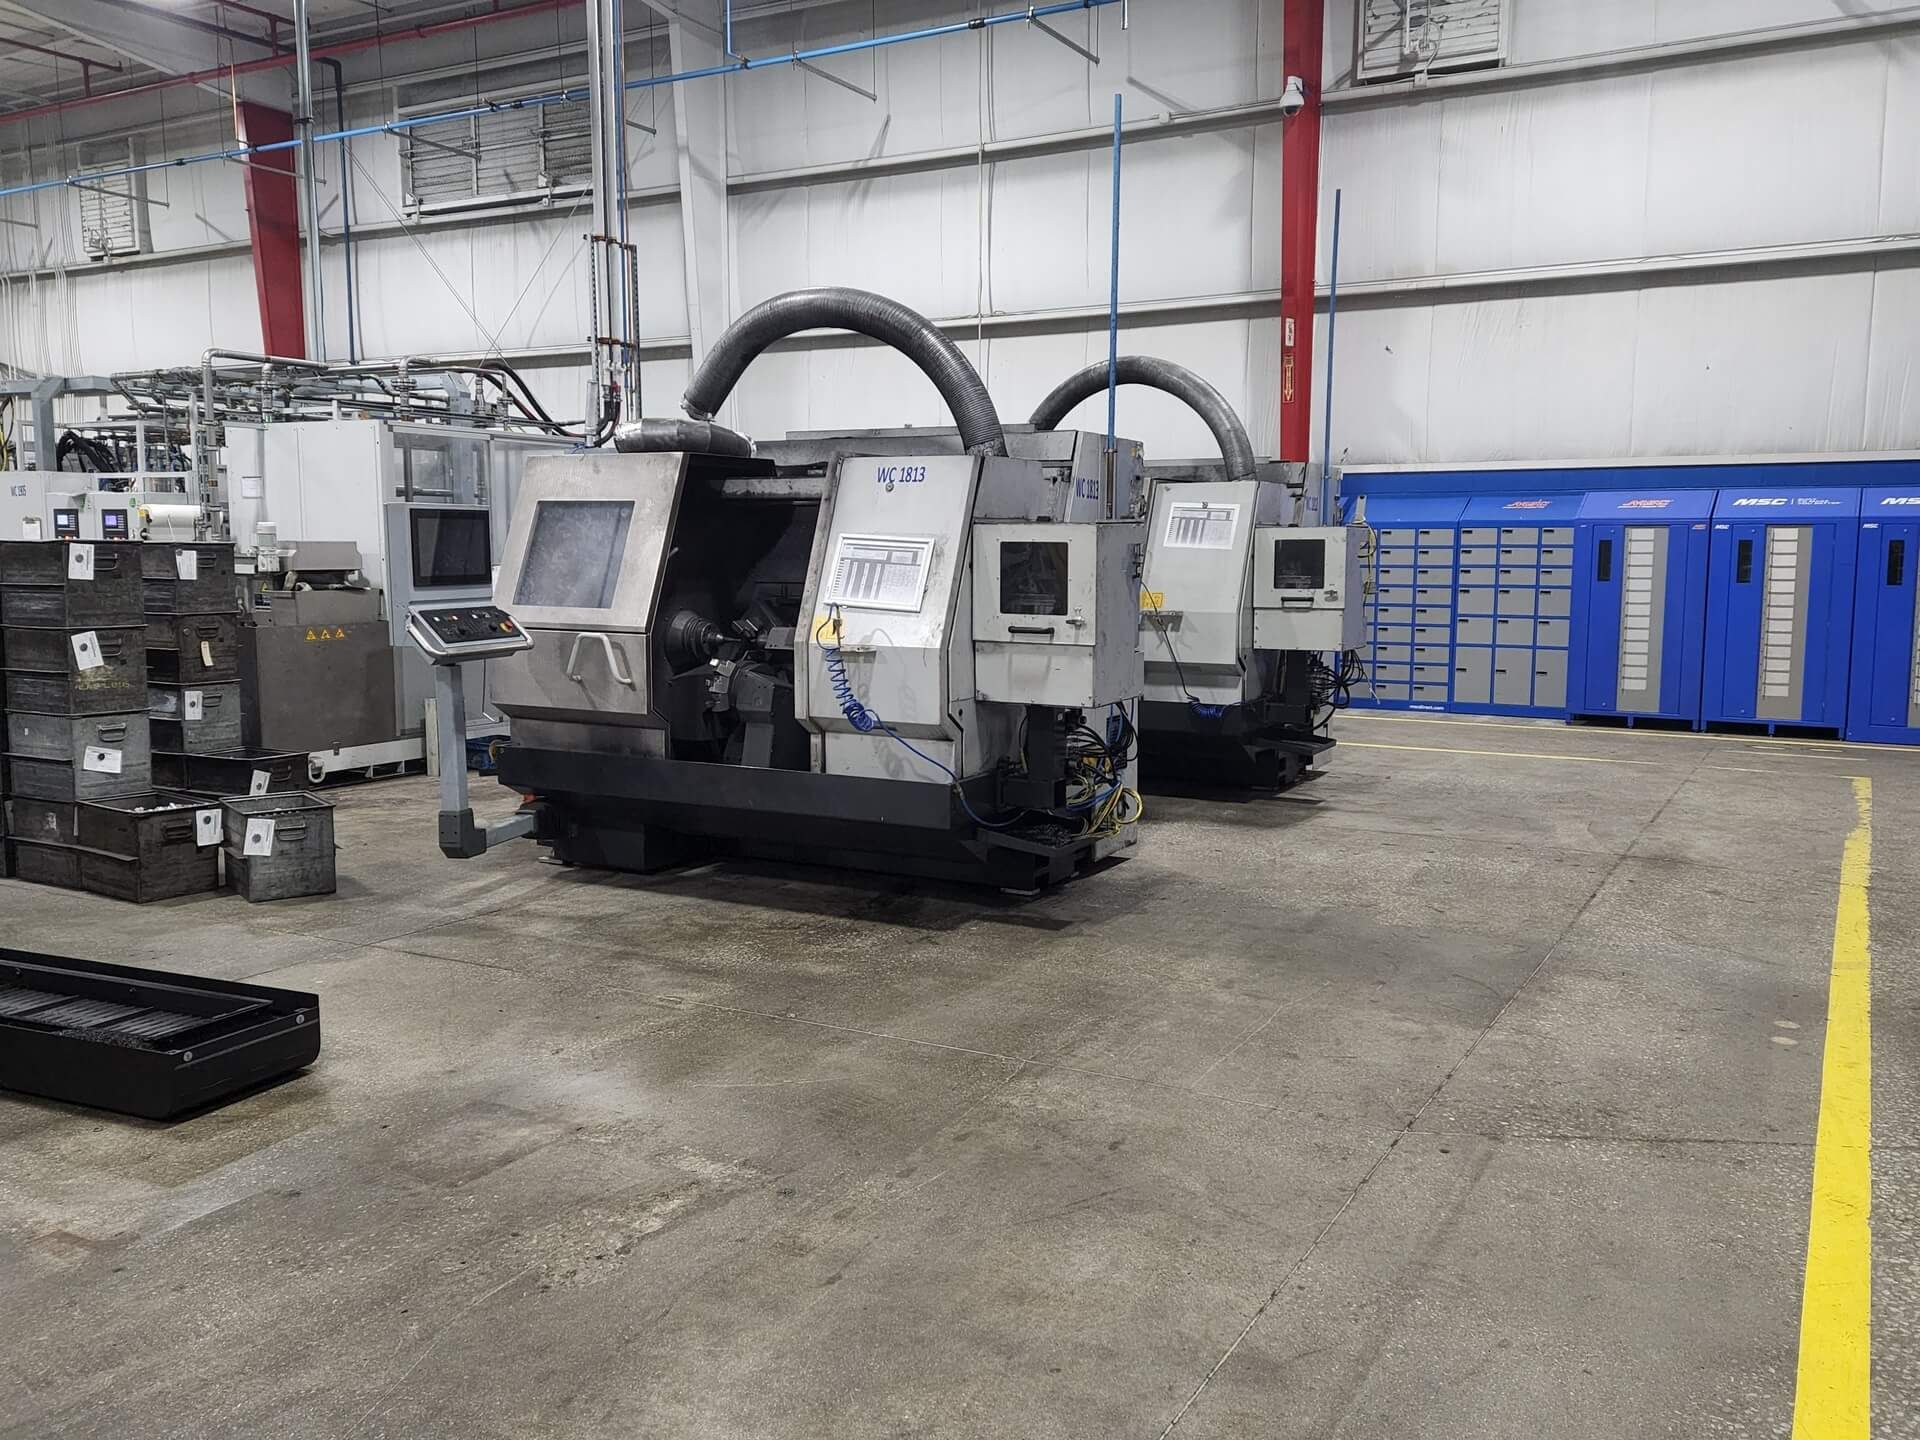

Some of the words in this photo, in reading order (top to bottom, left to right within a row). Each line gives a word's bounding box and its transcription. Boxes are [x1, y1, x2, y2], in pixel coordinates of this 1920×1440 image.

[877, 467, 897, 483] WC
[899, 466, 927, 483] 1813
[1076, 478, 1085, 498] WC
[1732, 498, 1788, 506] MSC
[1880, 497, 1920, 505] MS
